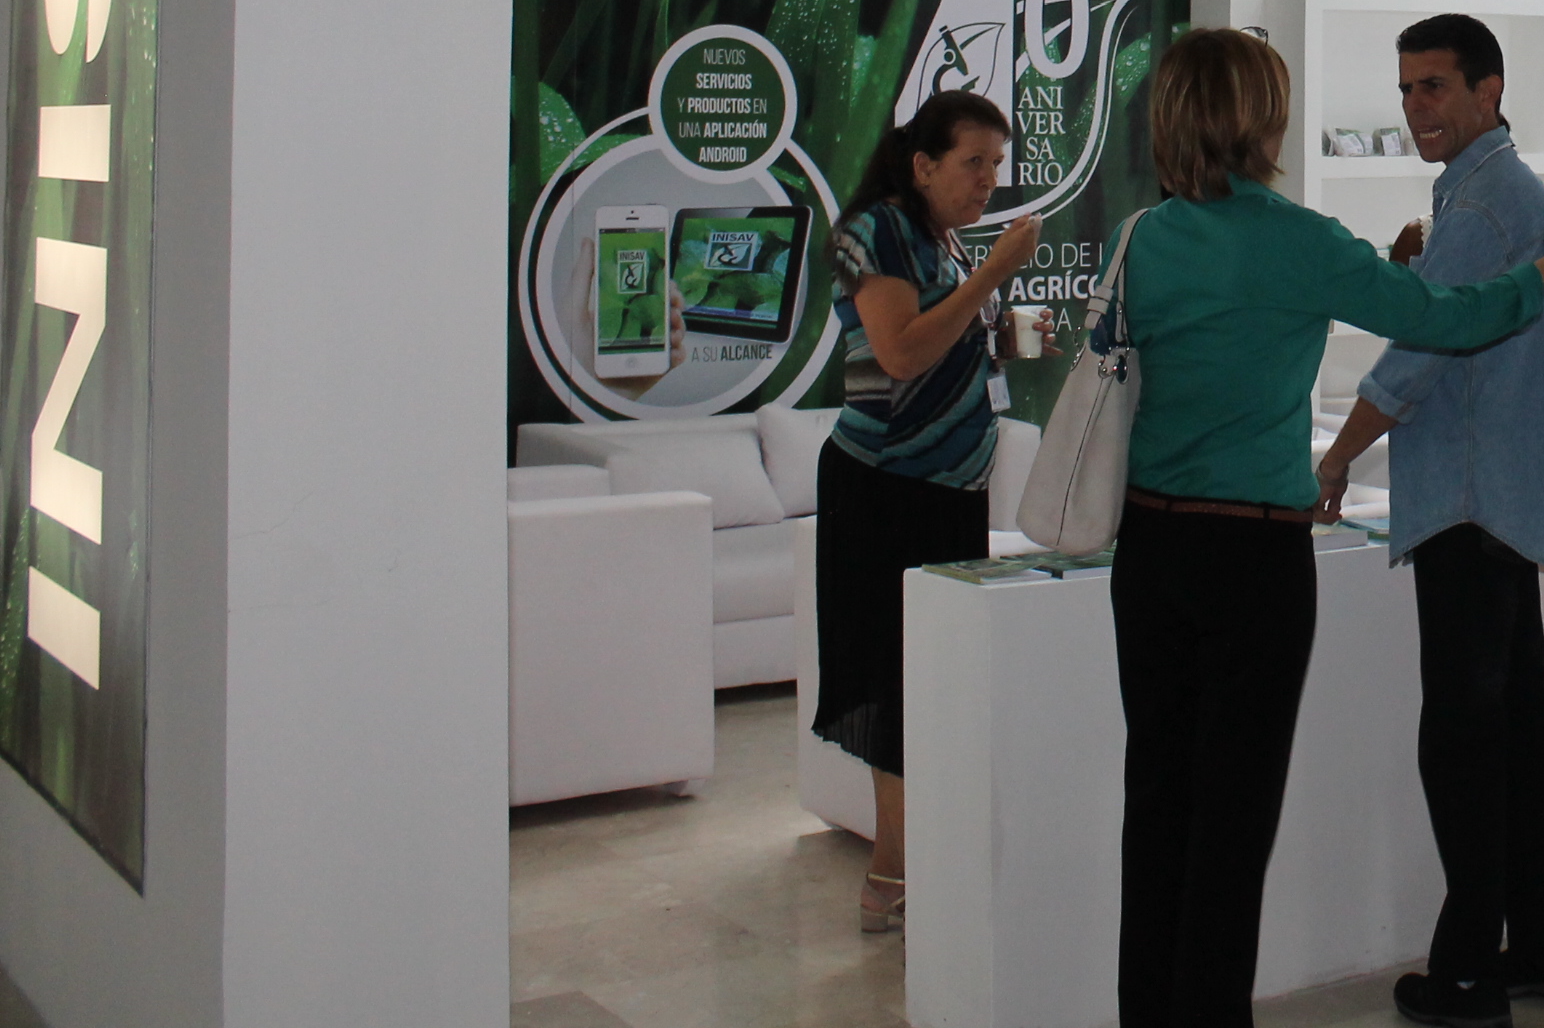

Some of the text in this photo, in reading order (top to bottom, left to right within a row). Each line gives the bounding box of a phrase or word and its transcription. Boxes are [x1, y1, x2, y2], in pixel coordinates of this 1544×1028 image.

[704, 48, 746, 65] NUEVOS
[696, 73, 752, 89] SERVICIOS
[677, 97, 767, 114] Y PRODUCTOS EN
[1018, 86, 1064, 109] ANI
[679, 119, 767, 138] UNA APLICACIÓN
[1016, 111, 1066, 135] VER
[699, 147, 747, 162] ANDROID
[1026, 137, 1055, 161] SA
[1018, 162, 1063, 186] RIO
[712, 233, 755, 243] INISAV
[619, 251, 645, 261] INISAV
[1061, 243, 1091, 268] DE
[691, 344, 773, 362] A SU ALCANCE
